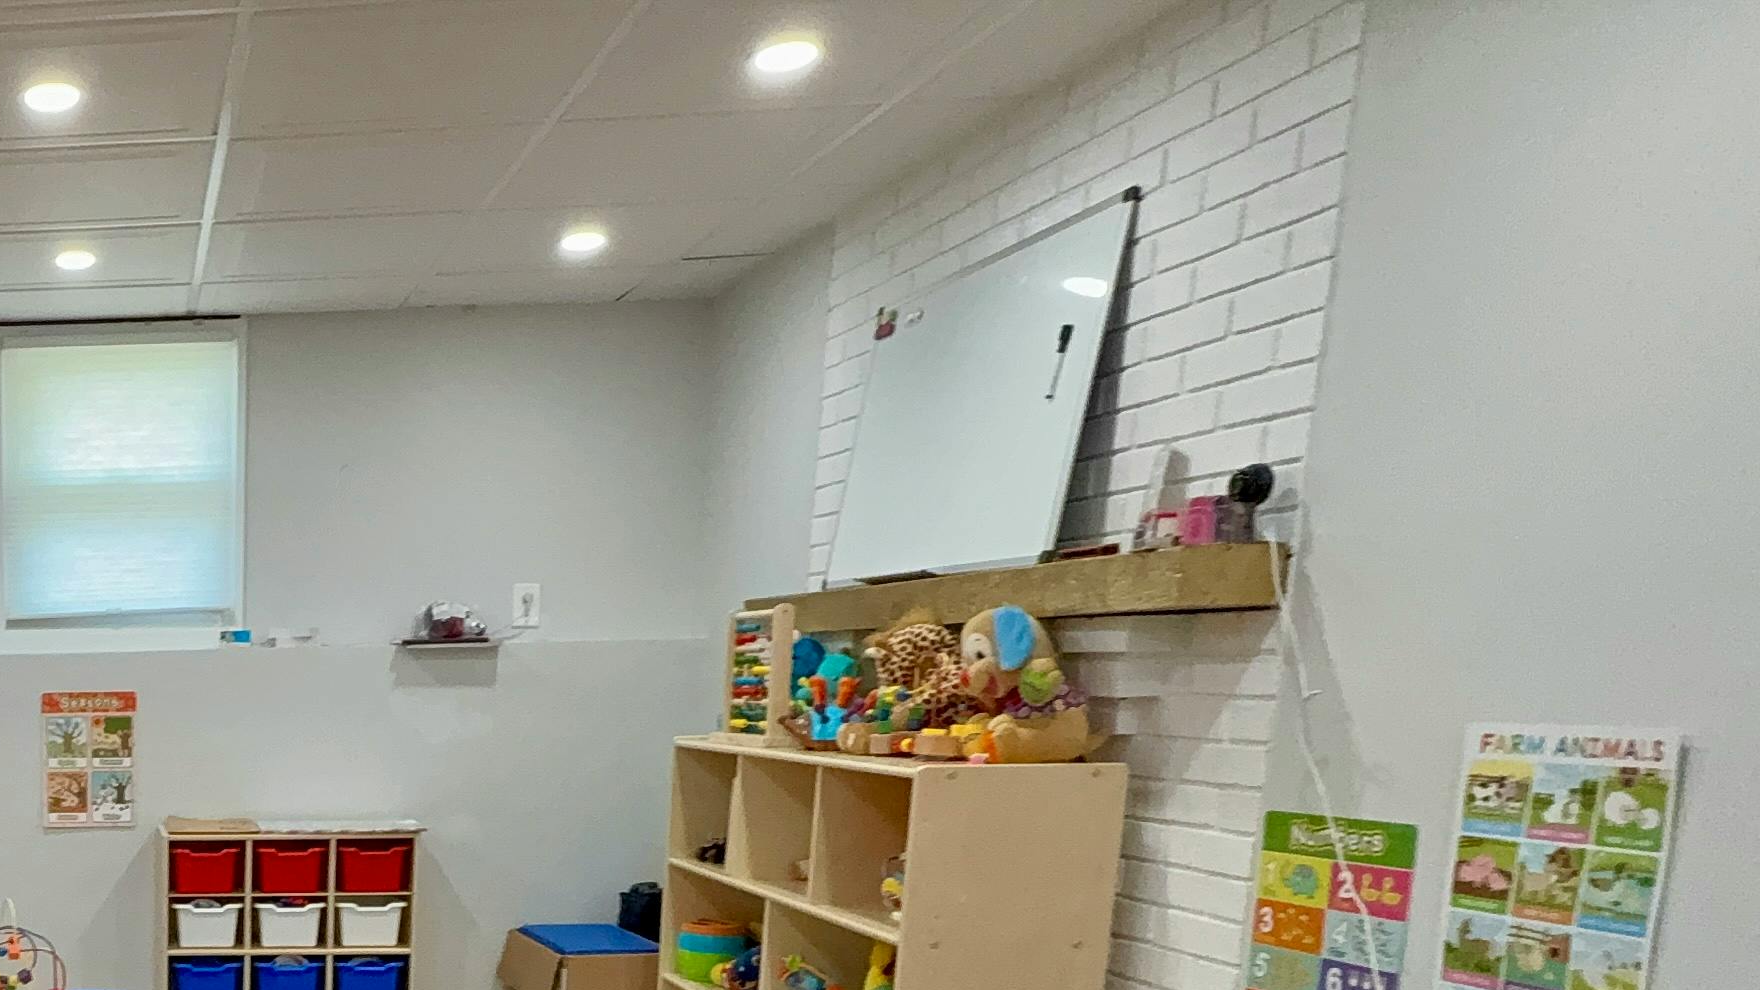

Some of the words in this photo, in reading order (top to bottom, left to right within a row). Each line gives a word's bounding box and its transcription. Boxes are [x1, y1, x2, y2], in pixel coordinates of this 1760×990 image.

[1479, 733, 1545, 754] FARM
[1553, 736, 1665, 762] ANIMALS
[1337, 869, 1356, 898] 2
[1258, 906, 1274, 932] 3
[1333, 920, 1348, 943] 4
[1255, 951, 1271, 977] 5
